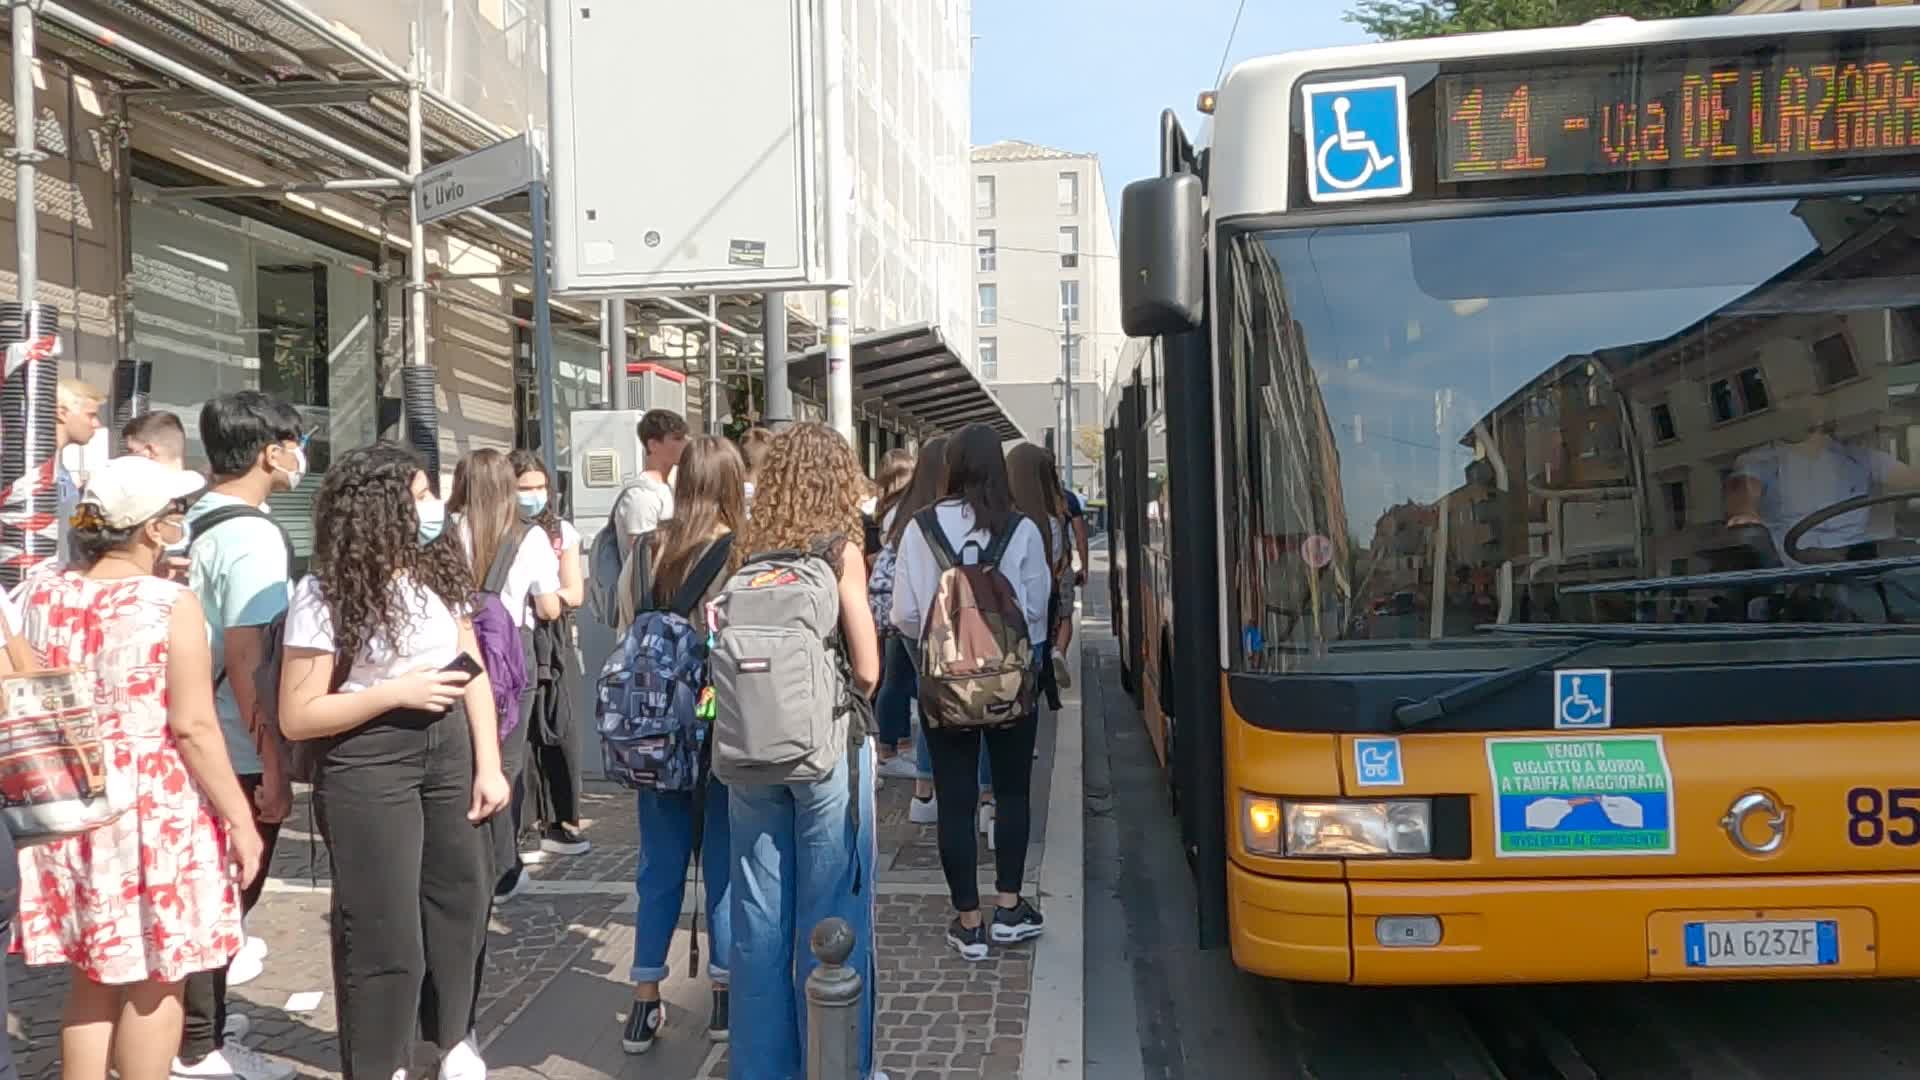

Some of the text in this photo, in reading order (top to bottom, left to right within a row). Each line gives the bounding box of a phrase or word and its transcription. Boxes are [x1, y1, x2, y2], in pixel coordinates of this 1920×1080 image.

[1451, 83, 1547, 172] 11
[1682, 71, 1739, 158] DE
[1545, 742, 1606, 759] VENDITA
[1512, 759, 1646, 775] BIGLIETTO A BORDO
[1502, 773, 1665, 792] A TARIFFA MAGGIORATA
[1707, 931, 1735, 958] DA
[1743, 928, 1814, 956] 623ZF
